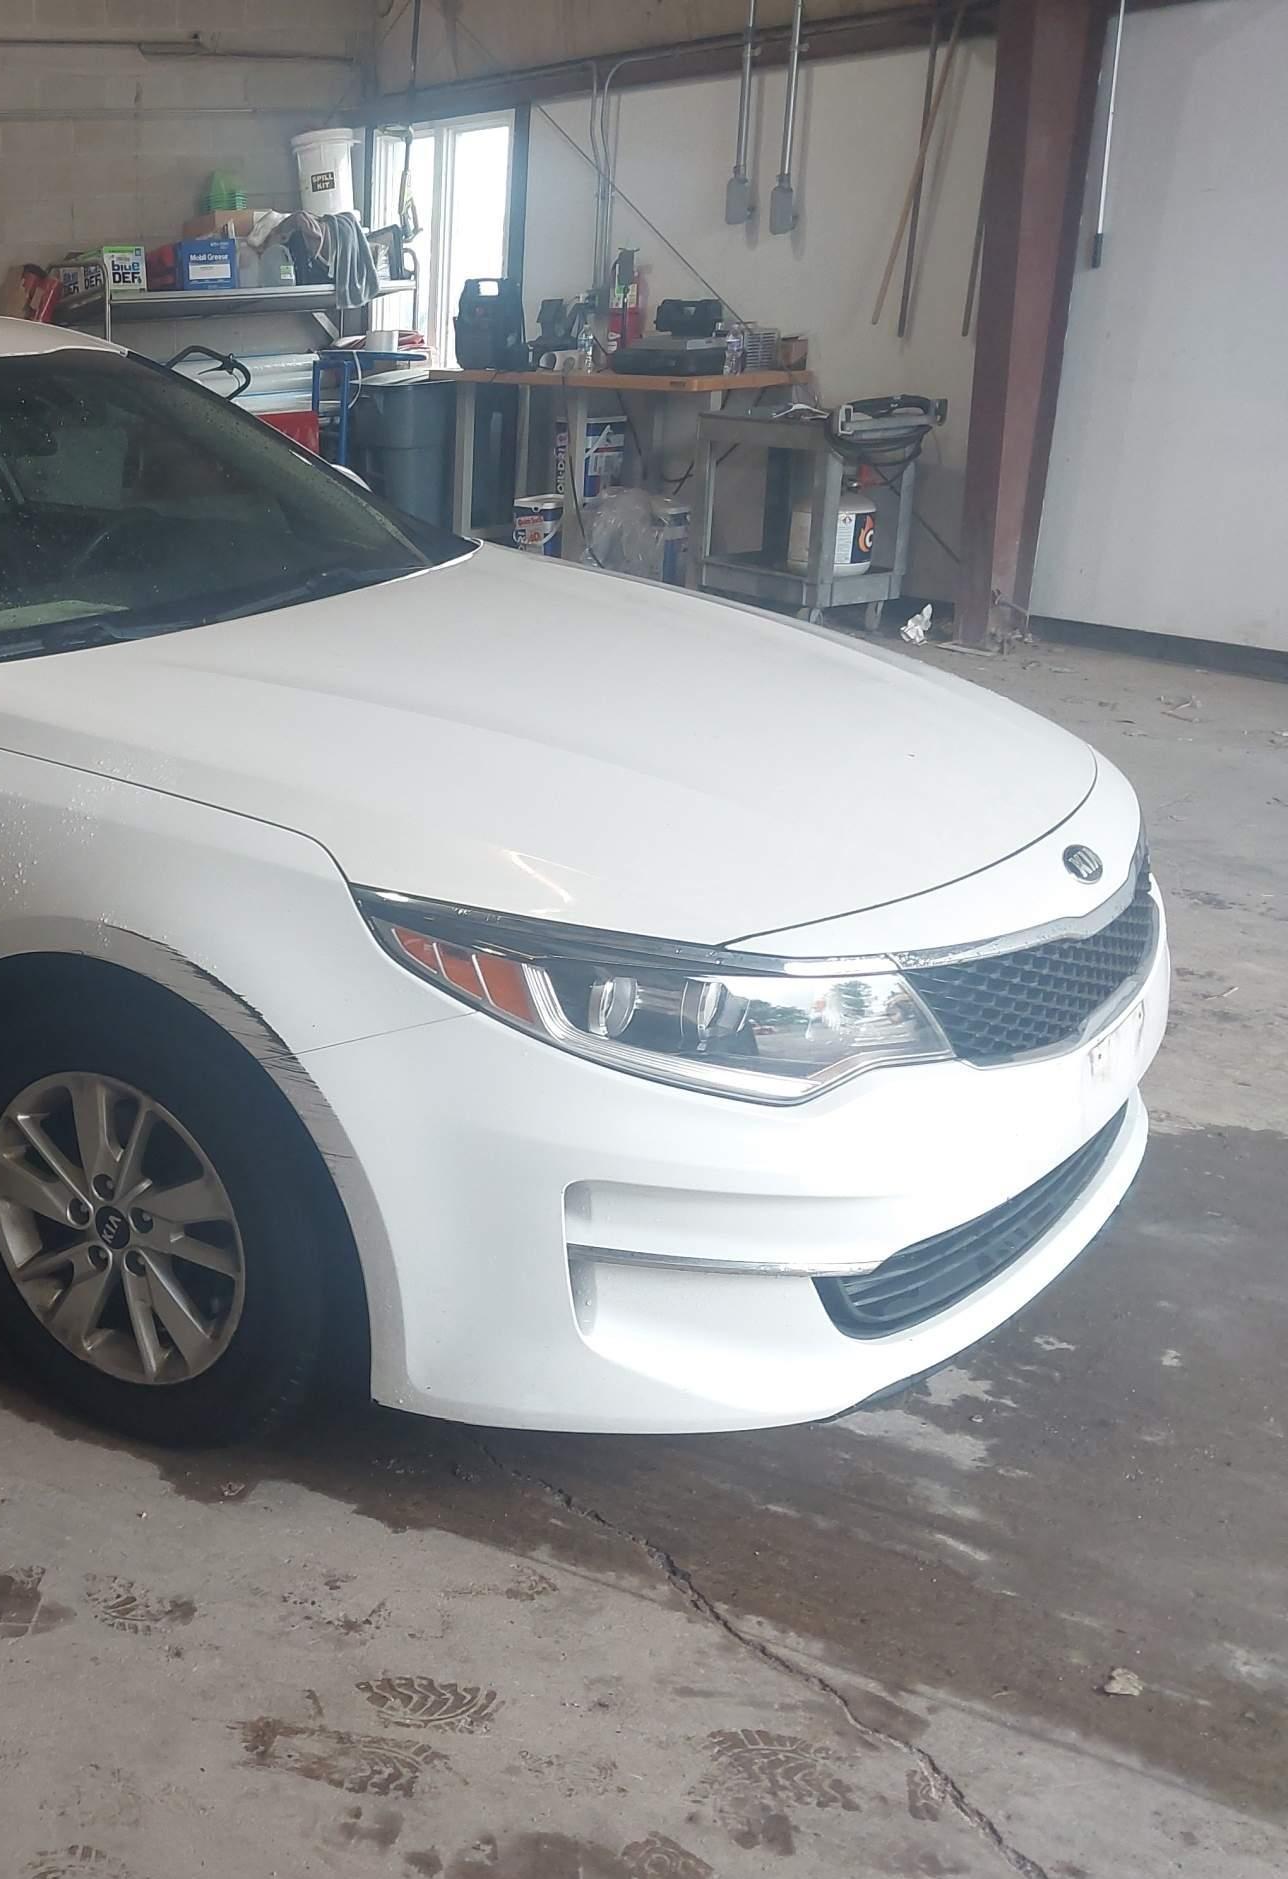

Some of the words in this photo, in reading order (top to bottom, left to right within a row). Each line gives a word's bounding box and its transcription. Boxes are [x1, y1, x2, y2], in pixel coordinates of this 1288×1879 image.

[317, 181, 329, 190] KIT
[208, 252, 228, 260] Grease
[112, 272, 140, 284] DEF
[102, 1215, 122, 1244] KIA
